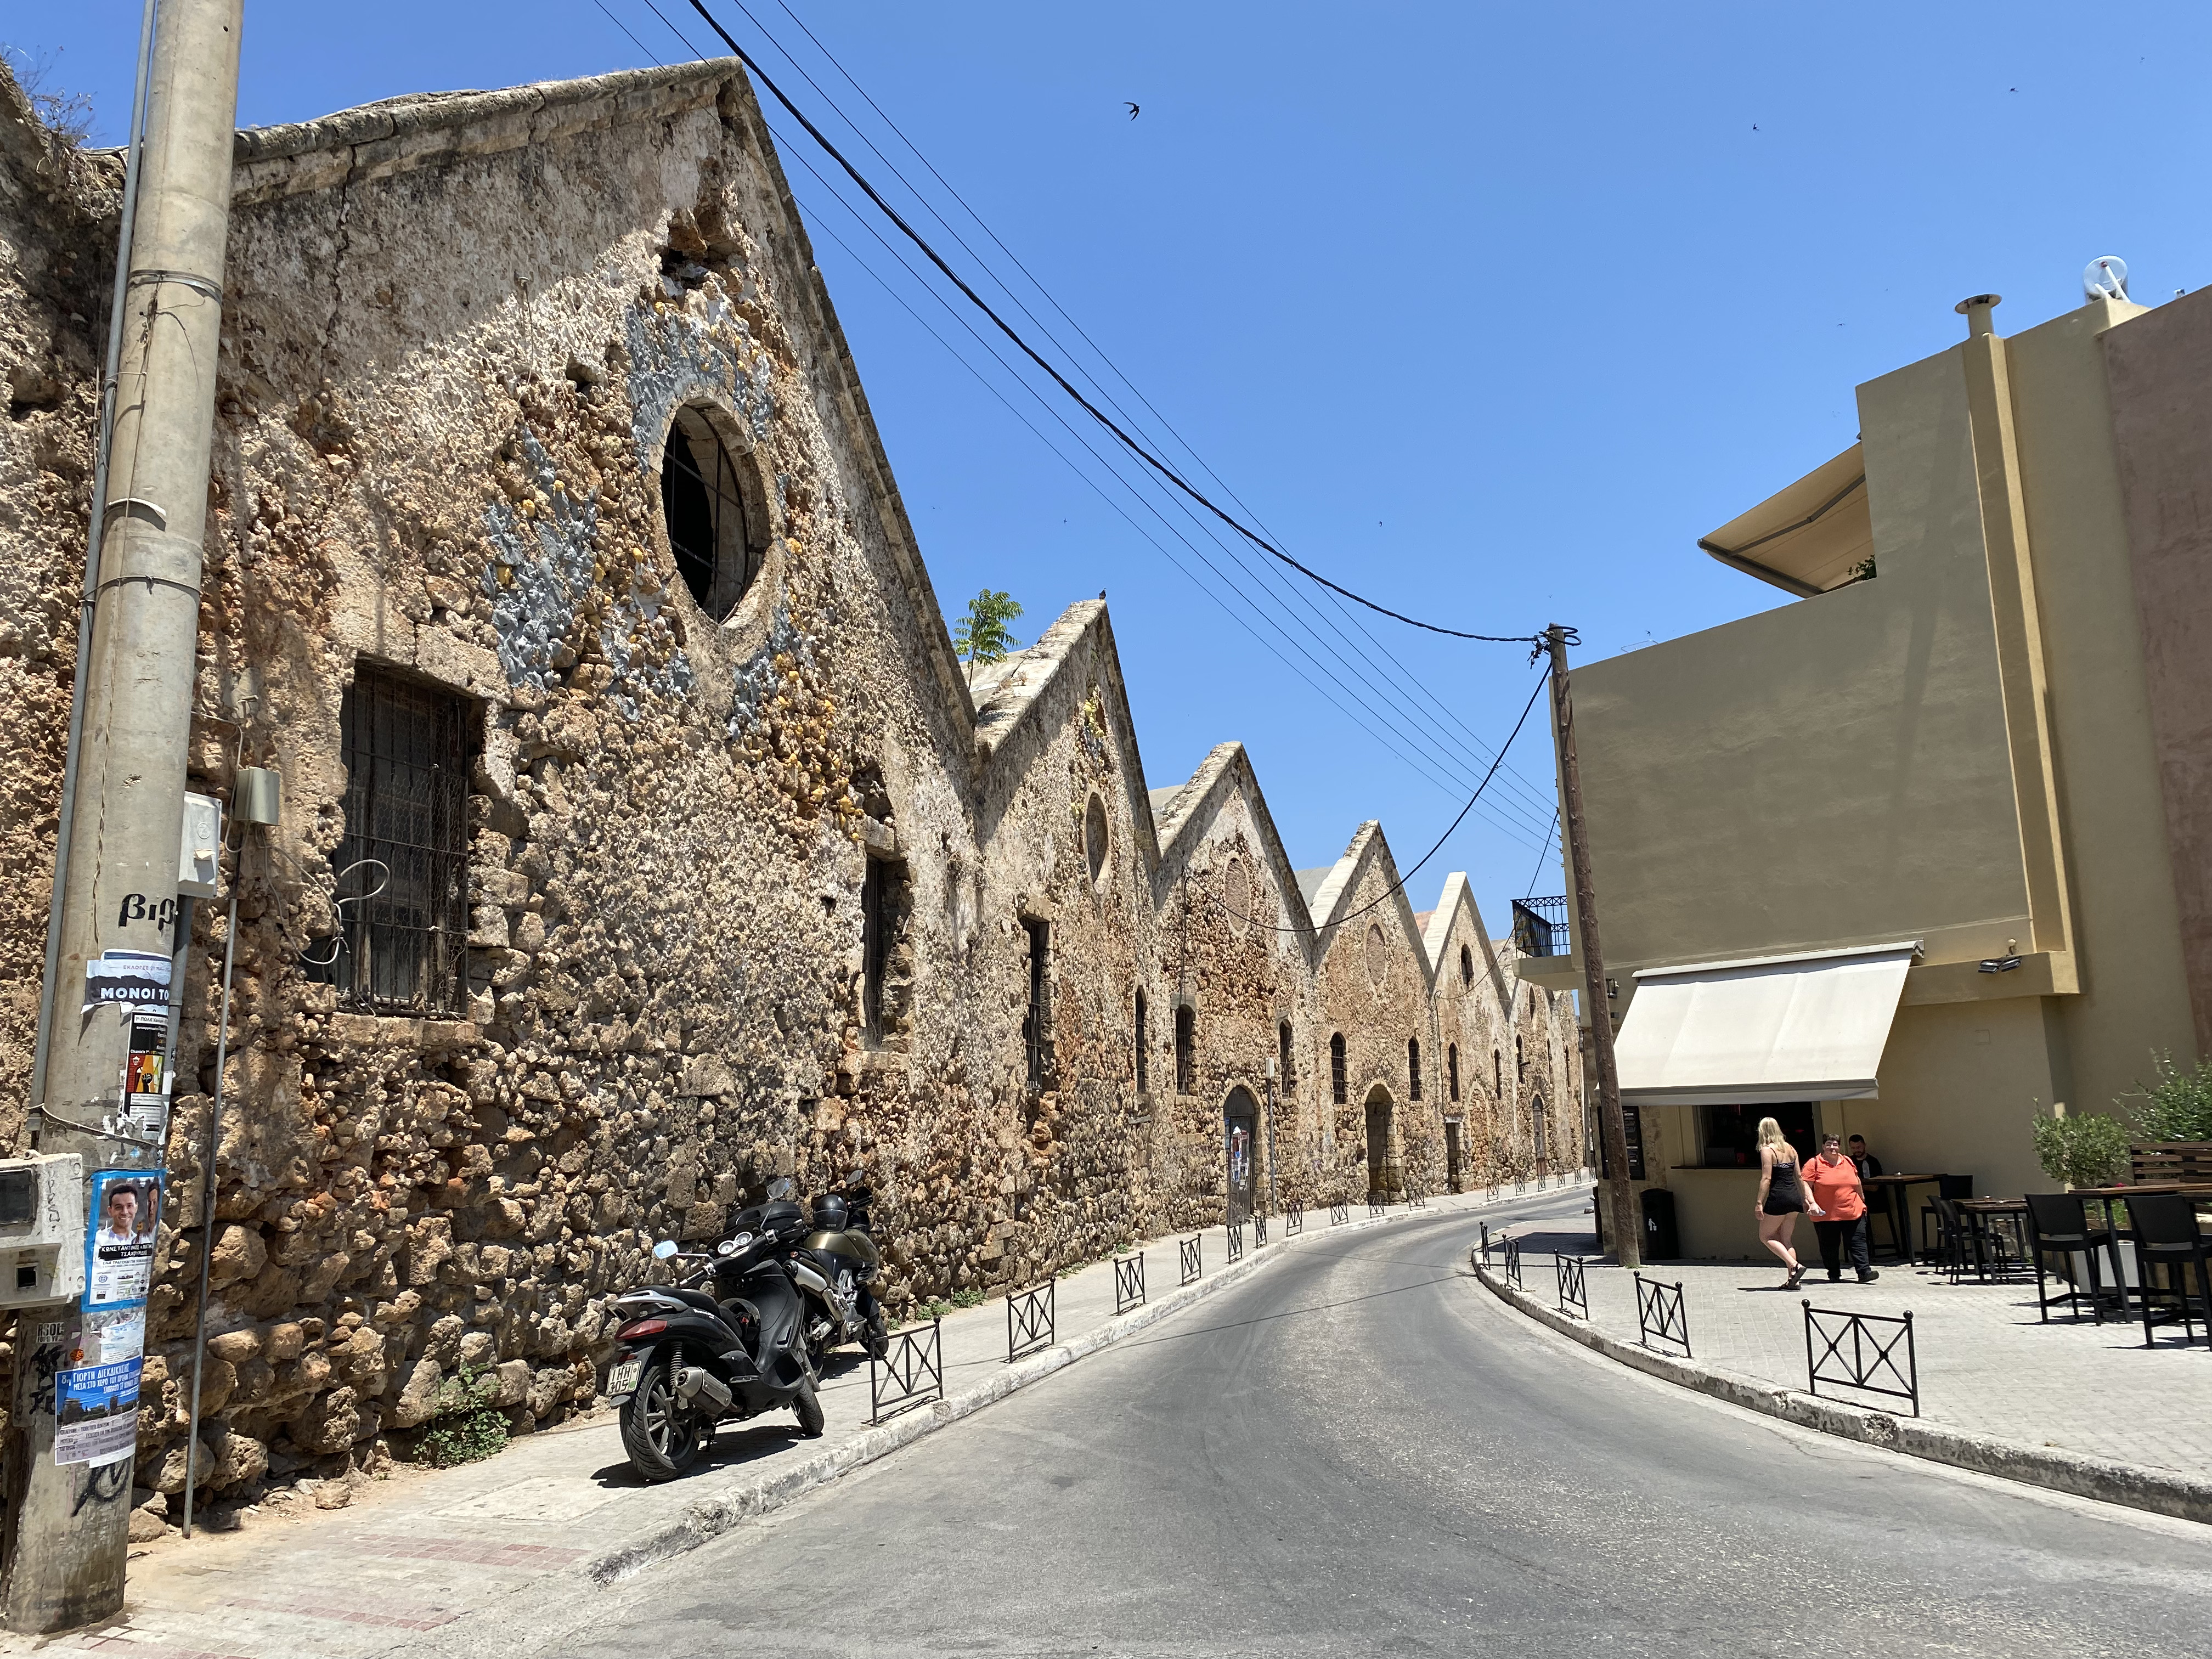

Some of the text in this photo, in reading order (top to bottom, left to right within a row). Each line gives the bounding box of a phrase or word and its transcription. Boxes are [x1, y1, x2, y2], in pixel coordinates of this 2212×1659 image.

[100, 988, 155, 1000] ΜΟΝΟΙ
[61, 1374, 71, 1386] 8η
[73, 1371, 95, 1383] ΓΙΟΡΤΗ
[608, 1379, 629, 1394] 305
